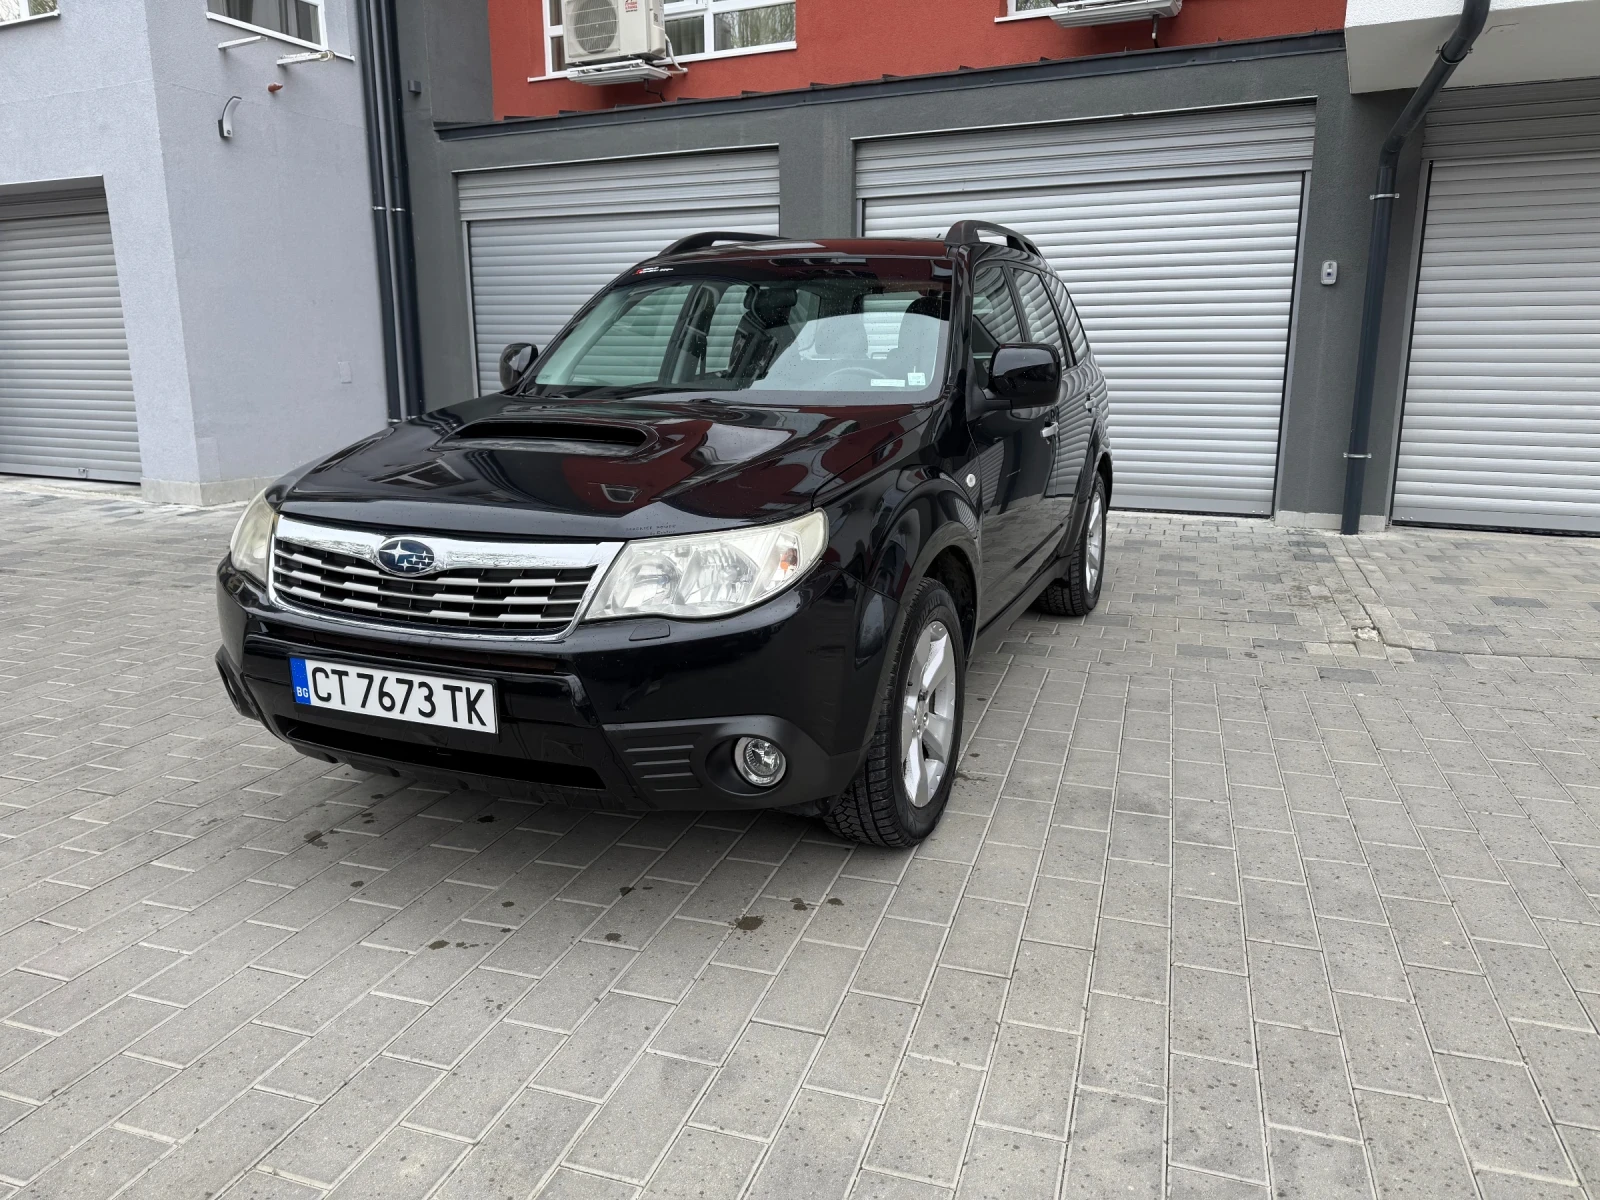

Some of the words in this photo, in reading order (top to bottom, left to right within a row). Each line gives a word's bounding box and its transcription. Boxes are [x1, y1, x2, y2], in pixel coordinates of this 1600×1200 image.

[296, 686, 309, 698] BG
[311, 666, 349, 706] CT
[356, 672, 437, 718] 7673
[442, 683, 488, 727] TK
